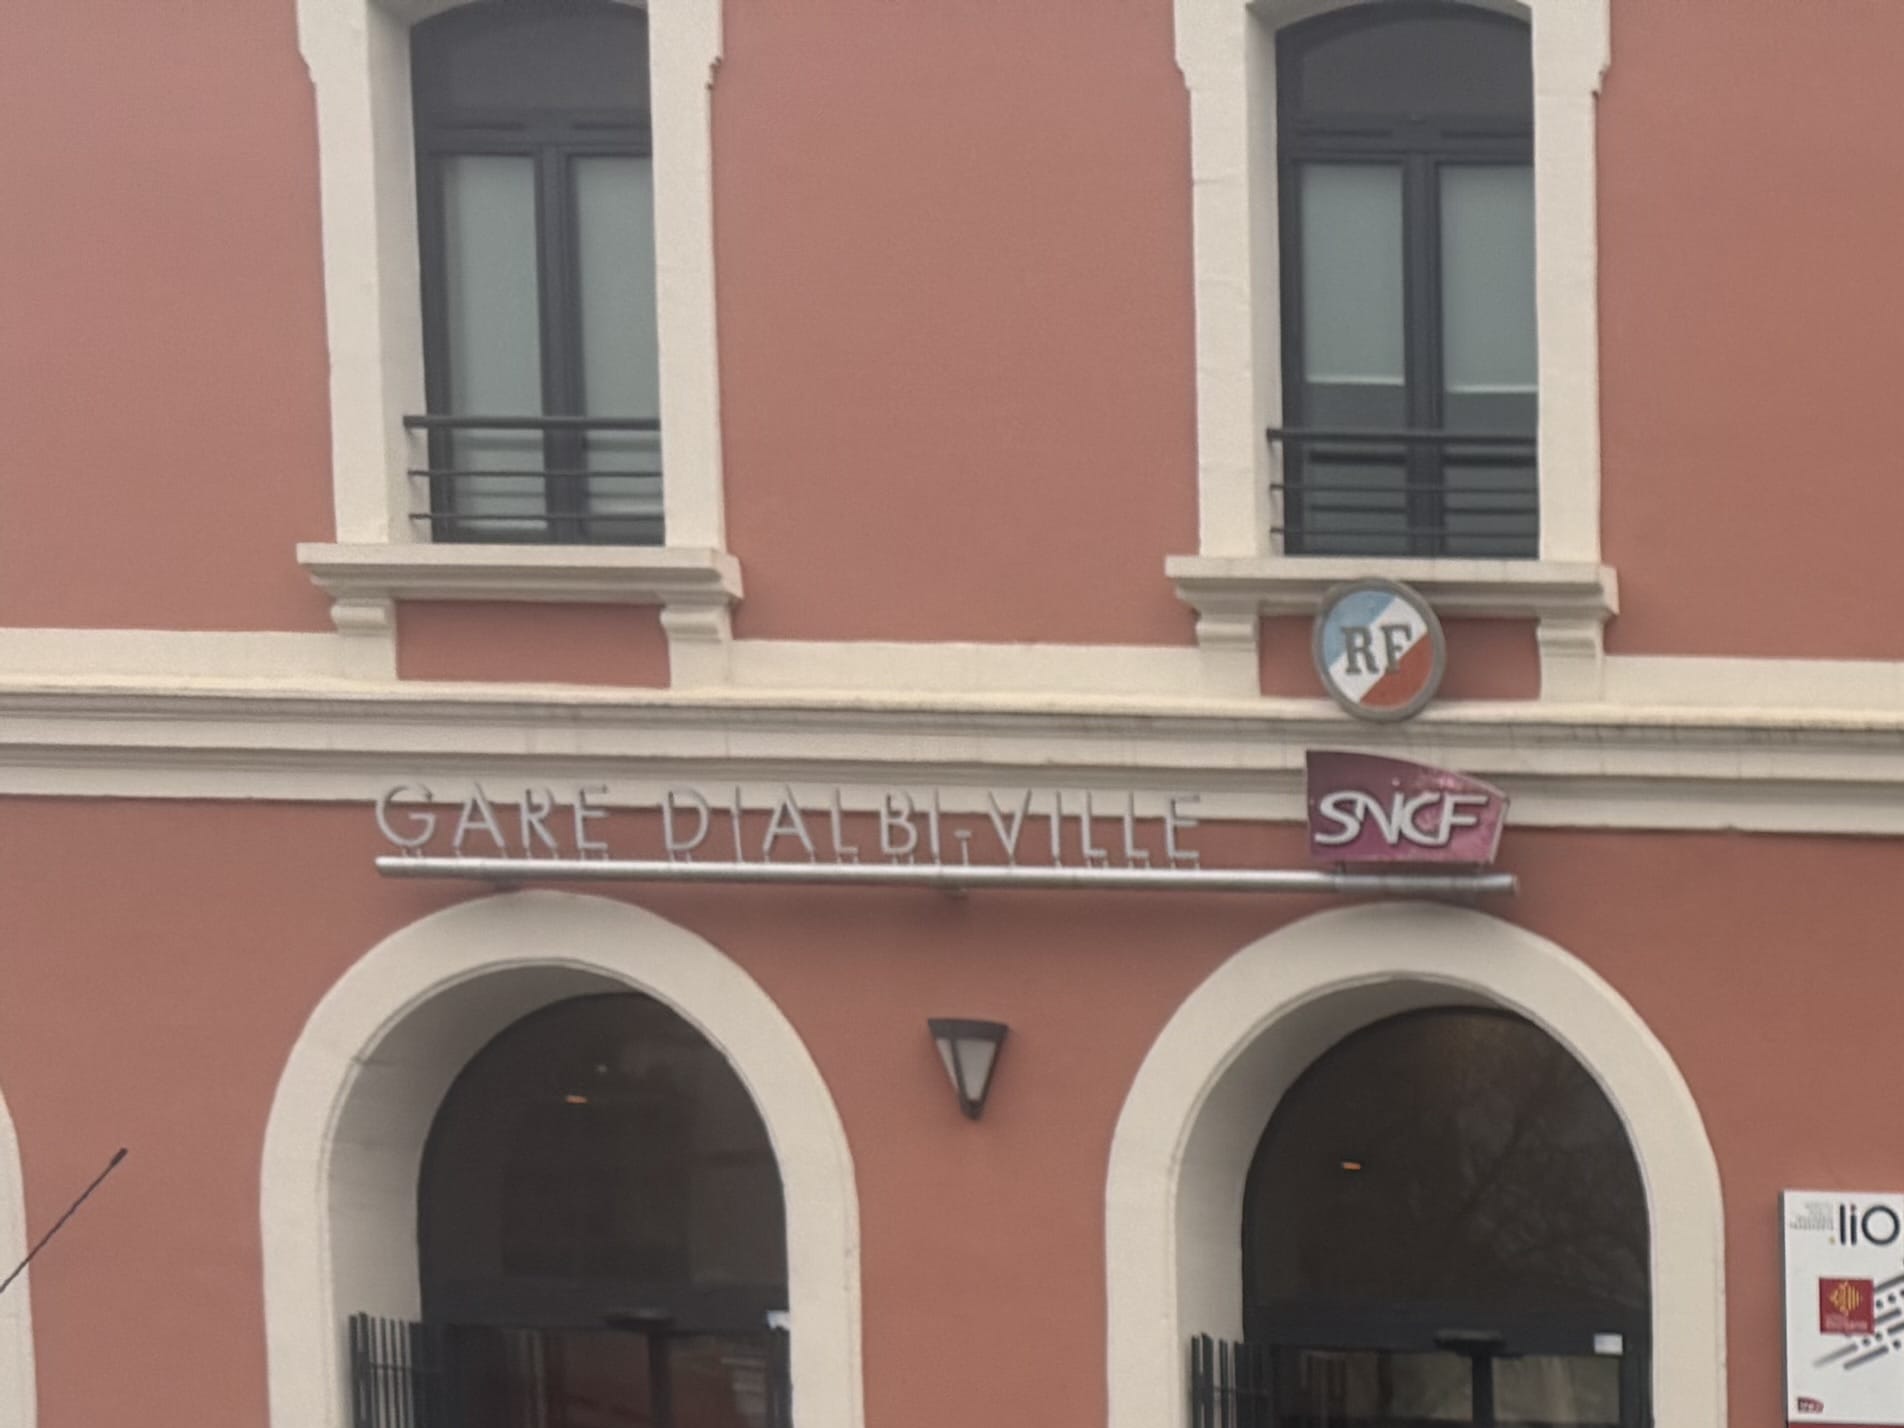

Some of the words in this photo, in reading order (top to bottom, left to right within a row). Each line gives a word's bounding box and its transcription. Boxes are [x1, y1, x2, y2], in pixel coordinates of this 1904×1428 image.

[1341, 621, 1413, 676] RF
[374, 783, 609, 852] GARE
[1314, 790, 1488, 846] SNCF
